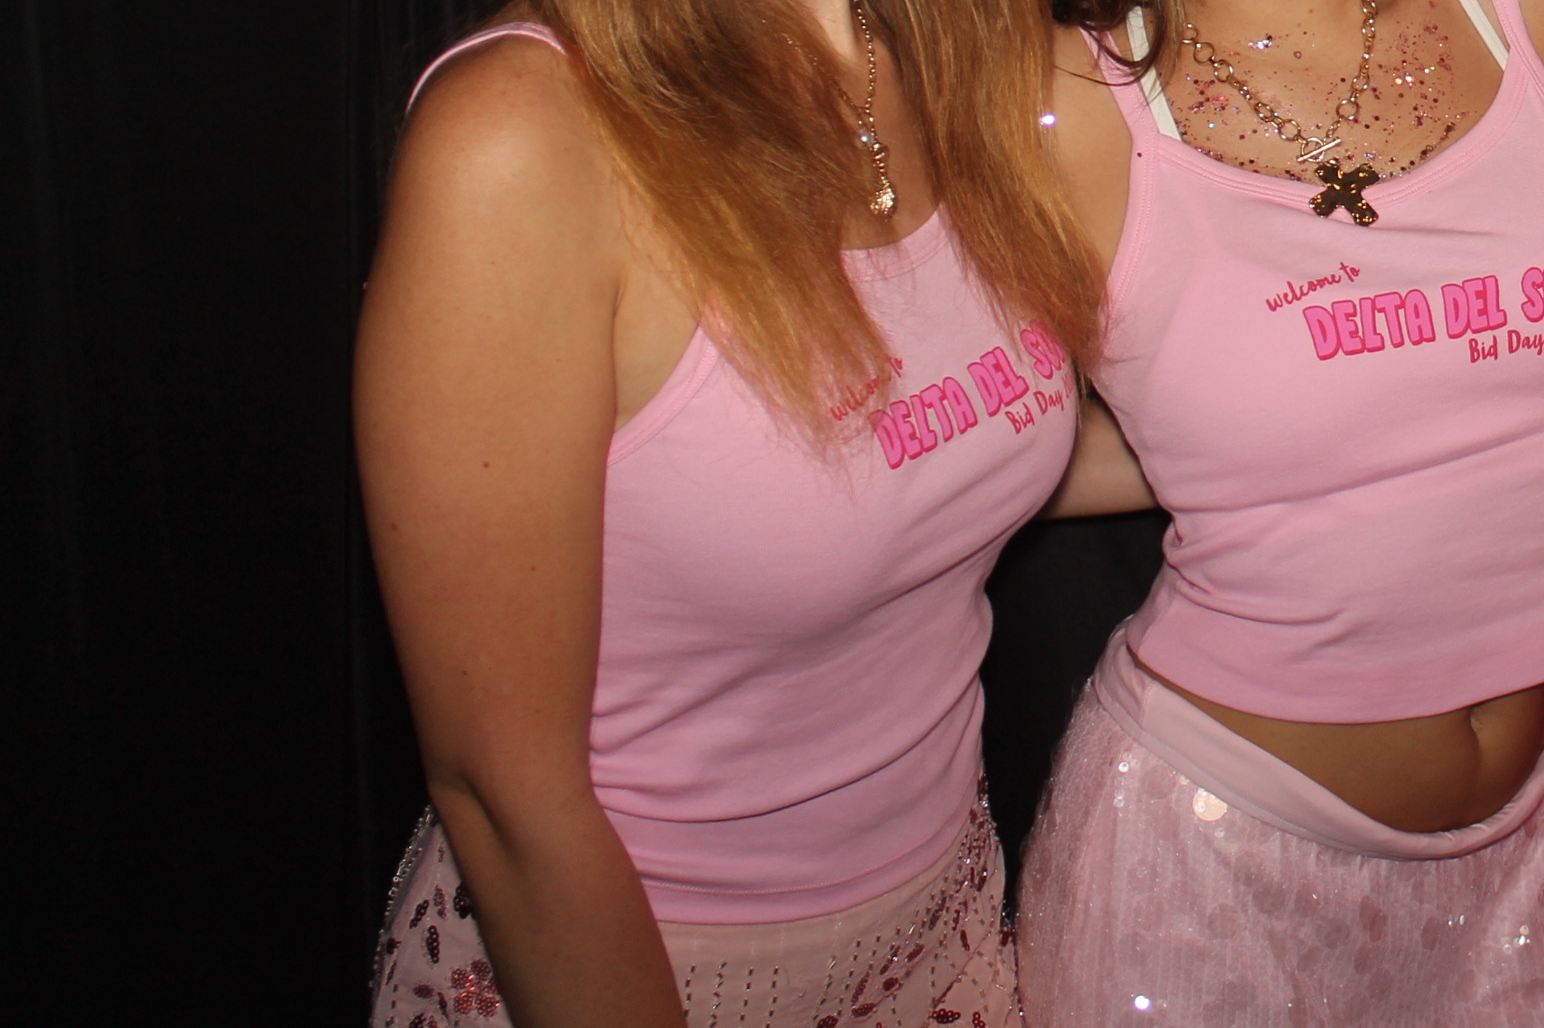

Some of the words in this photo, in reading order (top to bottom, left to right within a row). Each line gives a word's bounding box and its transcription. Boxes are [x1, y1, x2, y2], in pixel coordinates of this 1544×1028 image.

[1265, 273, 1342, 312] welcome
[1339, 261, 1361, 283] to
[1302, 289, 1436, 361] DELTA
[1440, 275, 1508, 340] DEL
[1468, 337, 1498, 363] Bid
[867, 376, 979, 470] DELTA
[967, 346, 1029, 418] DEL
[1004, 402, 1035, 435] Bid
[1033, 390, 1065, 416] Day
